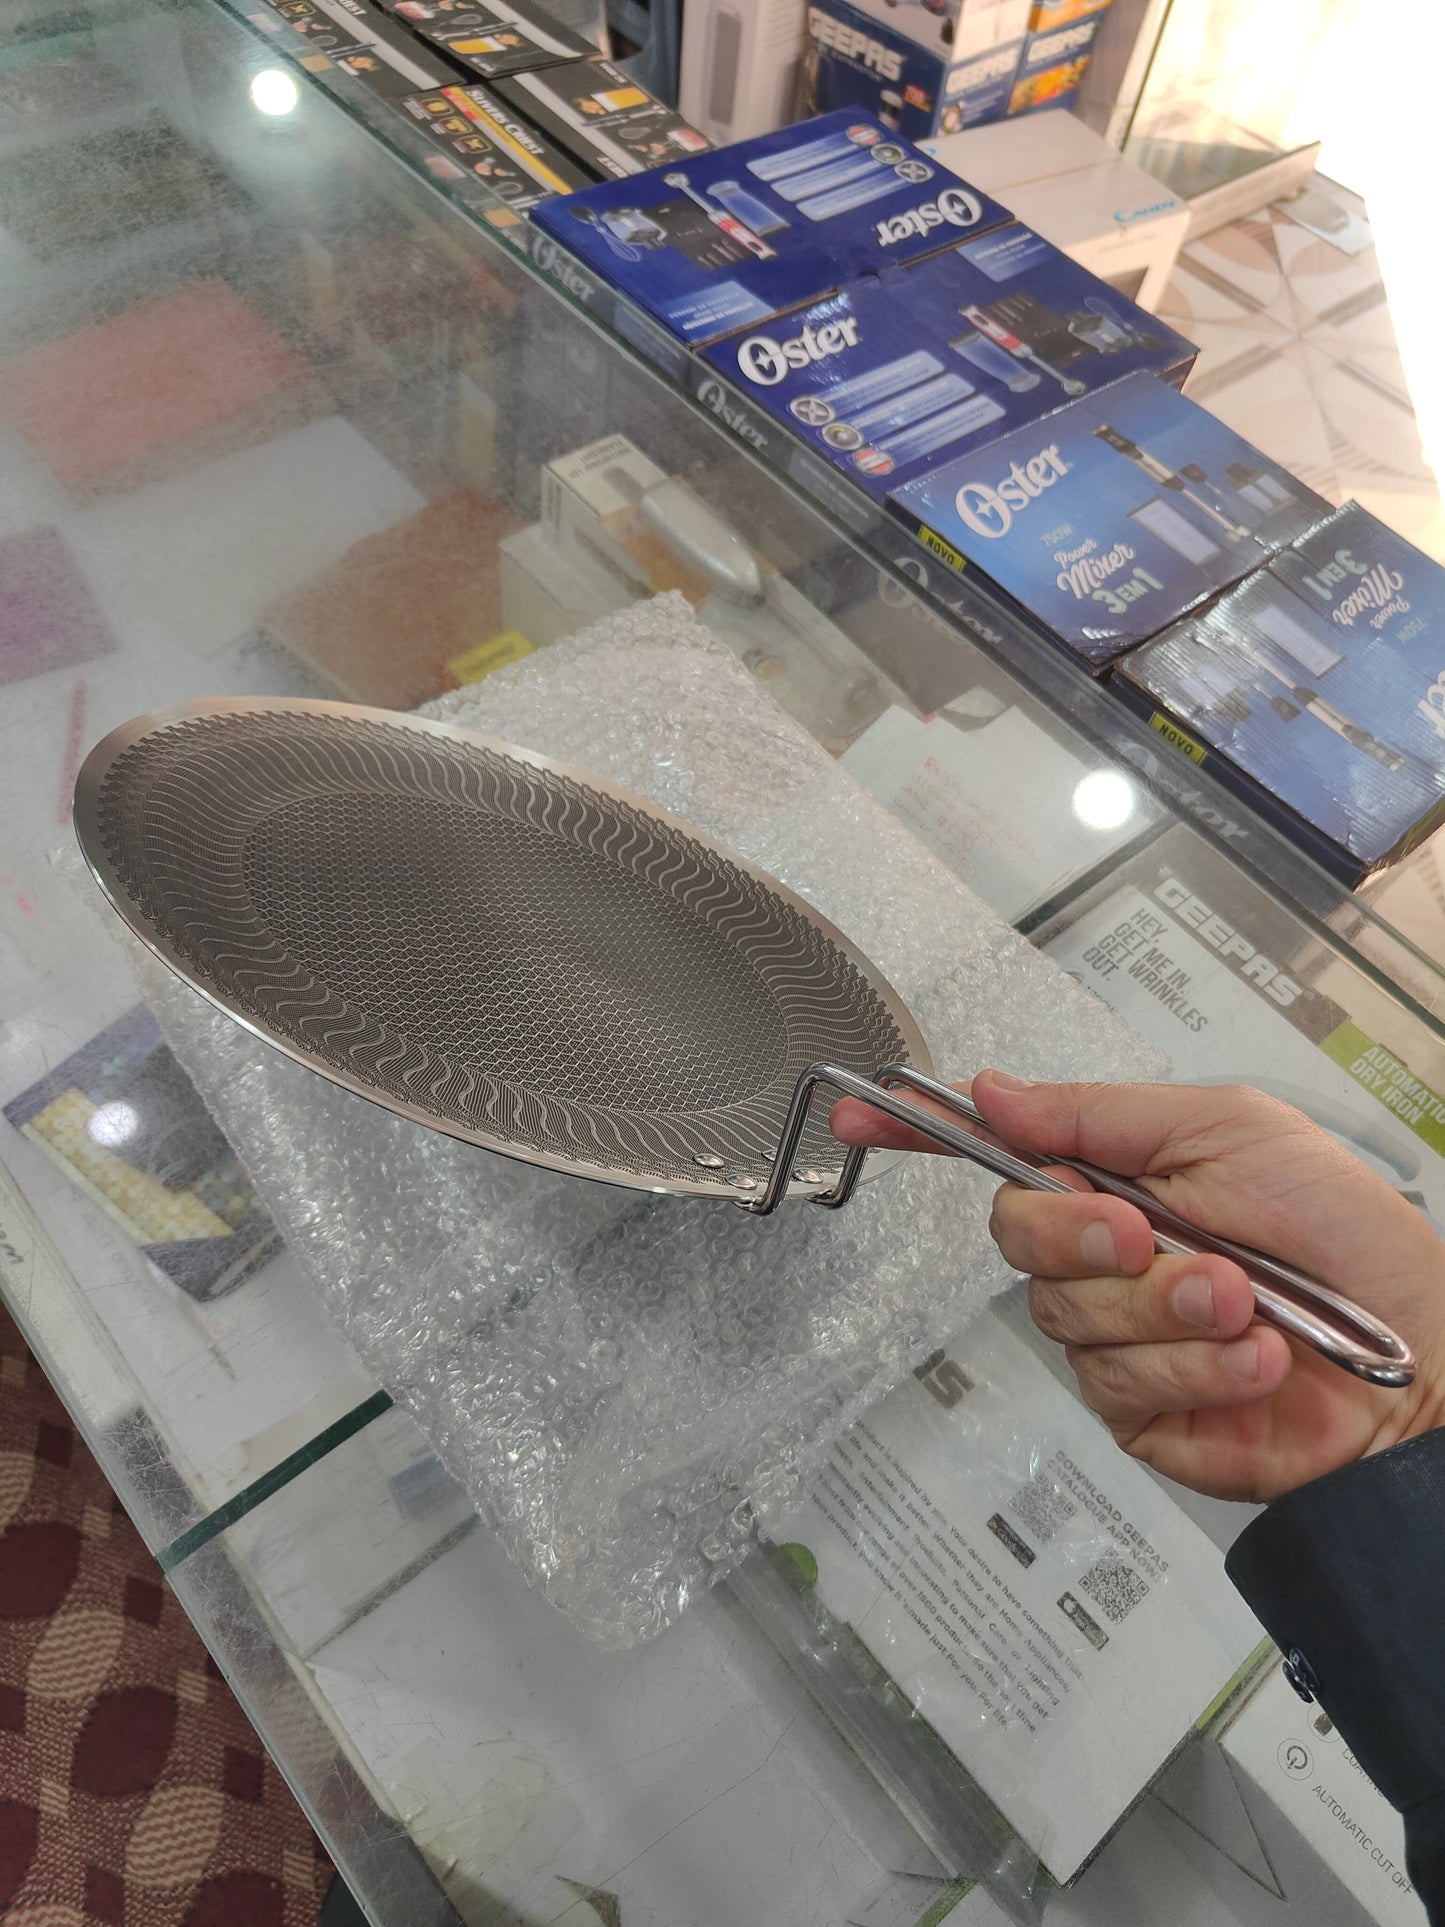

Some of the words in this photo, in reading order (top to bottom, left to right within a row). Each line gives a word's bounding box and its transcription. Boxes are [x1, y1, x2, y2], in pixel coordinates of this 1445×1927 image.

[875, 188, 983, 247] Oster
[533, 232, 596, 302] Oster
[737, 315, 860, 386] Oster
[697, 380, 770, 454] Oster
[955, 442, 1071, 539] Oster
[926, 537, 955, 566] NOVO
[1054, 537, 1097, 569] Power
[1056, 543, 1135, 600] Mixer
[1332, 563, 1404, 627] Mixer
[1369, 594, 1411, 630] Power
[1158, 724, 1194, 756] NOVO
[1082, 946, 1120, 982] OUT.
[1113, 922, 1150, 952] GET
[1142, 946, 1174, 975] ME
[1166, 968, 1192, 995] IN.
[1153, 877, 1304, 1008] GEEPAS
[1097, 934, 1135, 964] GET
[1126, 958, 1209, 1033] WRINKLES
[1348, 1057, 1387, 1091] DRY
[1380, 1085, 1426, 1125] IRON
[1361, 1045, 1445, 1124] AUTOMATIC
[1047, 1458, 1107, 1523] CATALOGUE
[1107, 1524, 1130, 1547] APP
[1055, 1450, 1122, 1522] DOWNLOAD
[1123, 1523, 1169, 1572] GEEPAS
[898, 1492, 905, 1501] it
[932, 1531, 966, 1571] Whether
[965, 1569, 984, 1593] they
[985, 1592, 998, 1609] are
[838, 1498, 856, 1520] from
[899, 1571, 916, 1592] over
[983, 1669, 998, 1688] the
[873, 1566, 895, 1593] know
[908, 1607, 931, 1636] made
[929, 1632, 947, 1655] just
[950, 1526, 967, 1547] Your
[967, 1547, 991, 1575] desire
[992, 1575, 1001, 1586] to
[1002, 1585, 1021, 1609] have
[1021, 1608, 1063, 1659] something
[951, 1578, 985, 1619] Personal
[988, 1621, 1008, 1646] Care
[1011, 1649, 1021, 1662] or
[908, 1555, 949, 1604] innovating
[949, 1602, 958, 1615] to
[958, 1612, 981, 1640] make
[980, 1640, 998, 1661] sure
[998, 1659, 1016, 1682] that
[1031, 1699, 1048, 1720] get
[1311, 1784, 1373, 1851] AUTOMATIC
[1370, 1847, 1396, 1875] CUT
[1391, 1870, 1415, 1896] OFF
